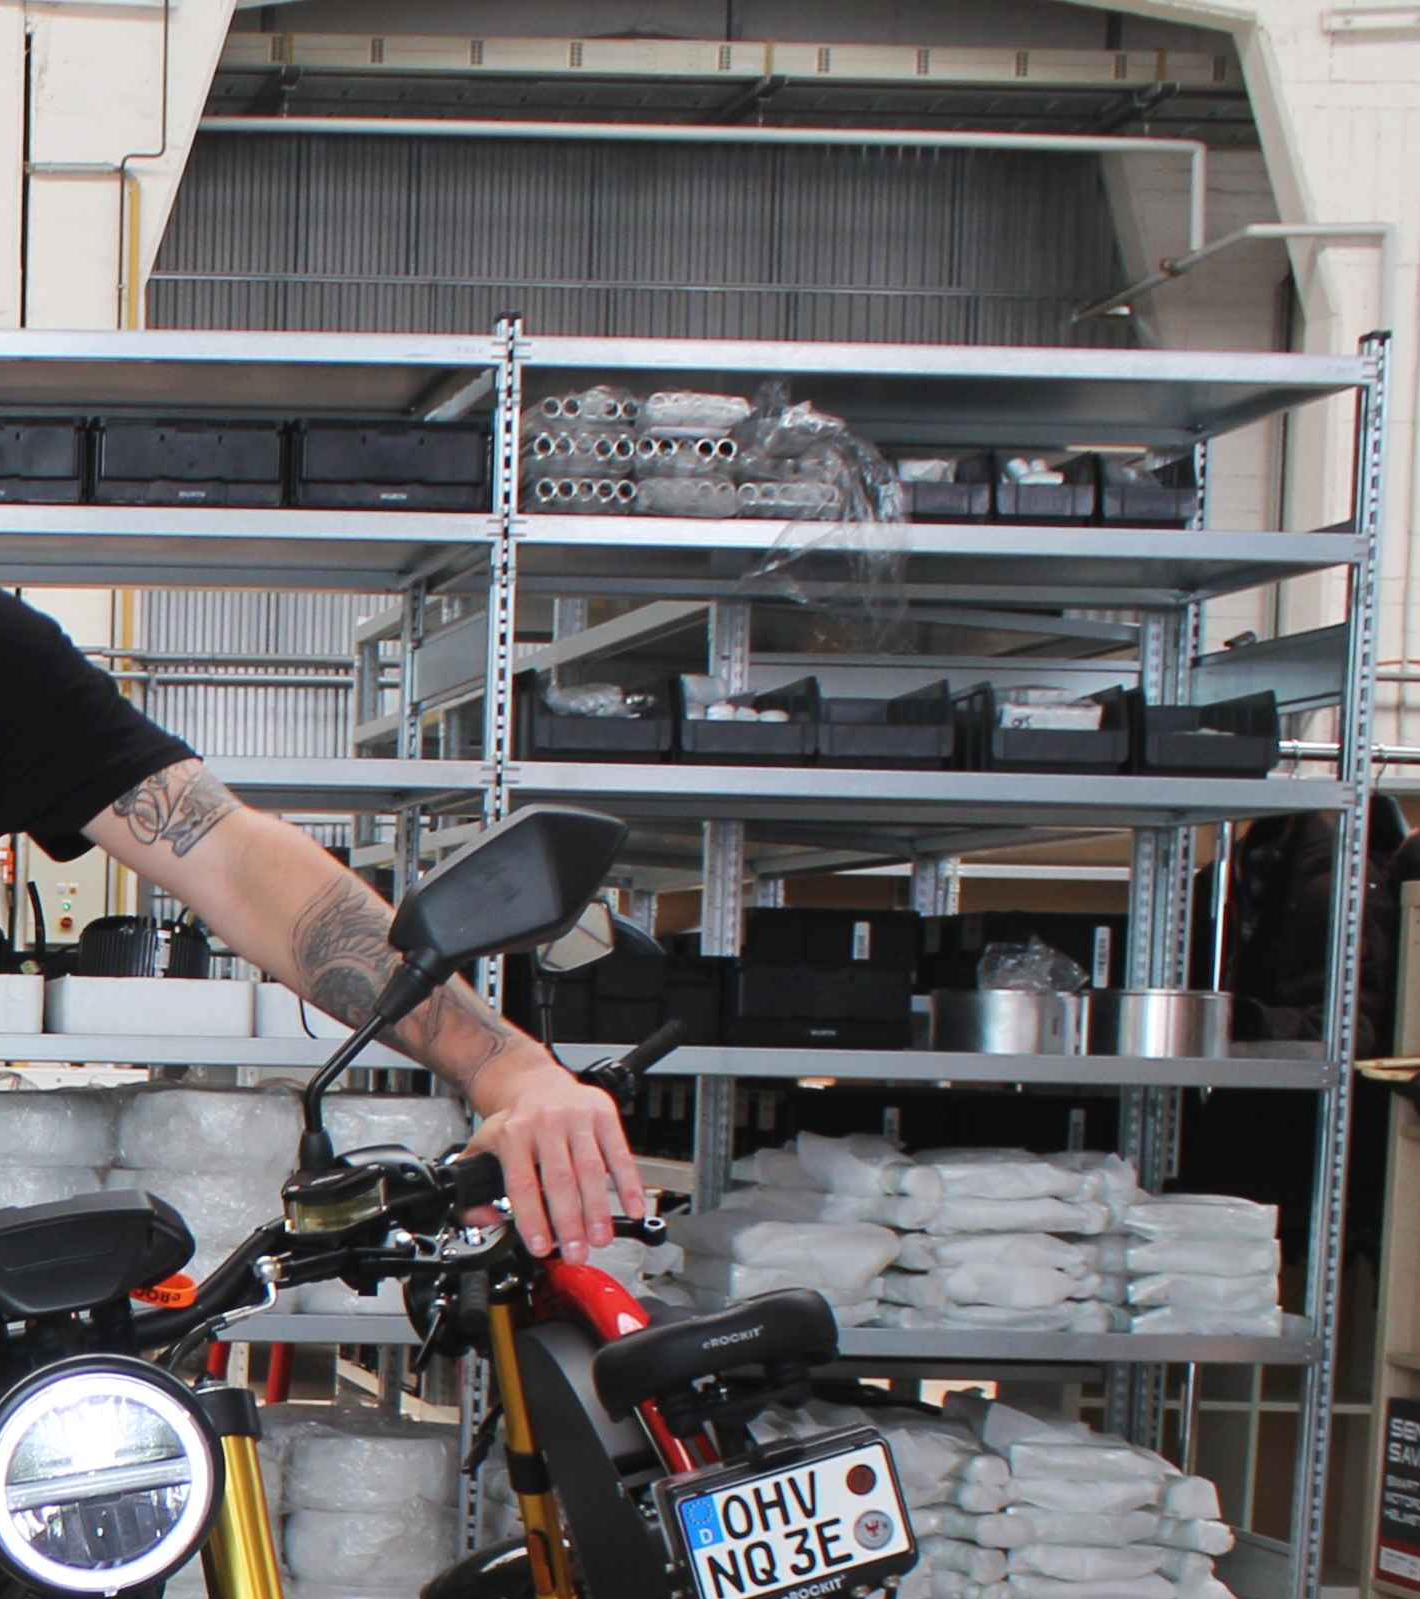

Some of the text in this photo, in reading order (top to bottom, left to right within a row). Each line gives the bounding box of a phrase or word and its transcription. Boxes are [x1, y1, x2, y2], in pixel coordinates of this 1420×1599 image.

[698, 1528, 714, 1545] D
[722, 1471, 816, 1540] OHV
[706, 1518, 853, 1599] NQ 3E
